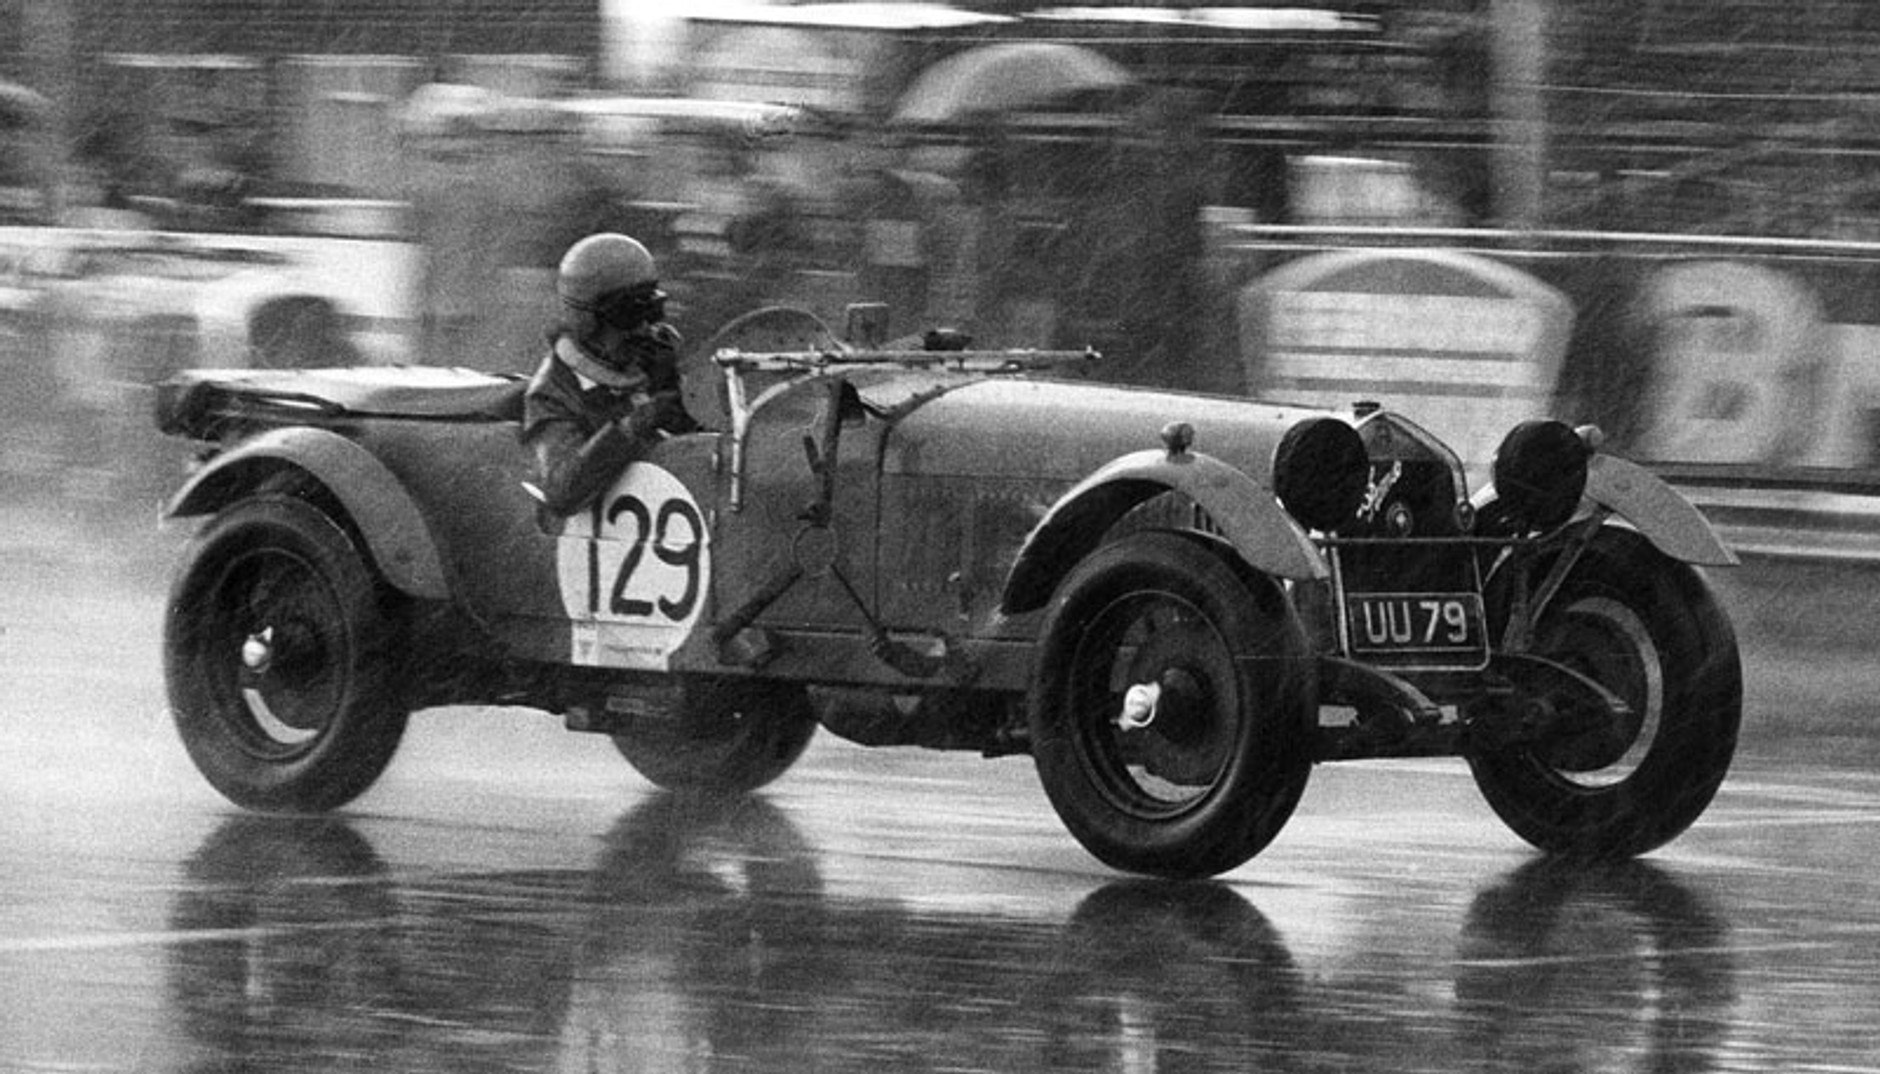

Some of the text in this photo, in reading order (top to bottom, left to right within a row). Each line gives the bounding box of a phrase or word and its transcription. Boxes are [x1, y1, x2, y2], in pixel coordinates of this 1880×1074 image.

[588, 494, 703, 622] 129
[1363, 601, 1468, 643] UU 79
